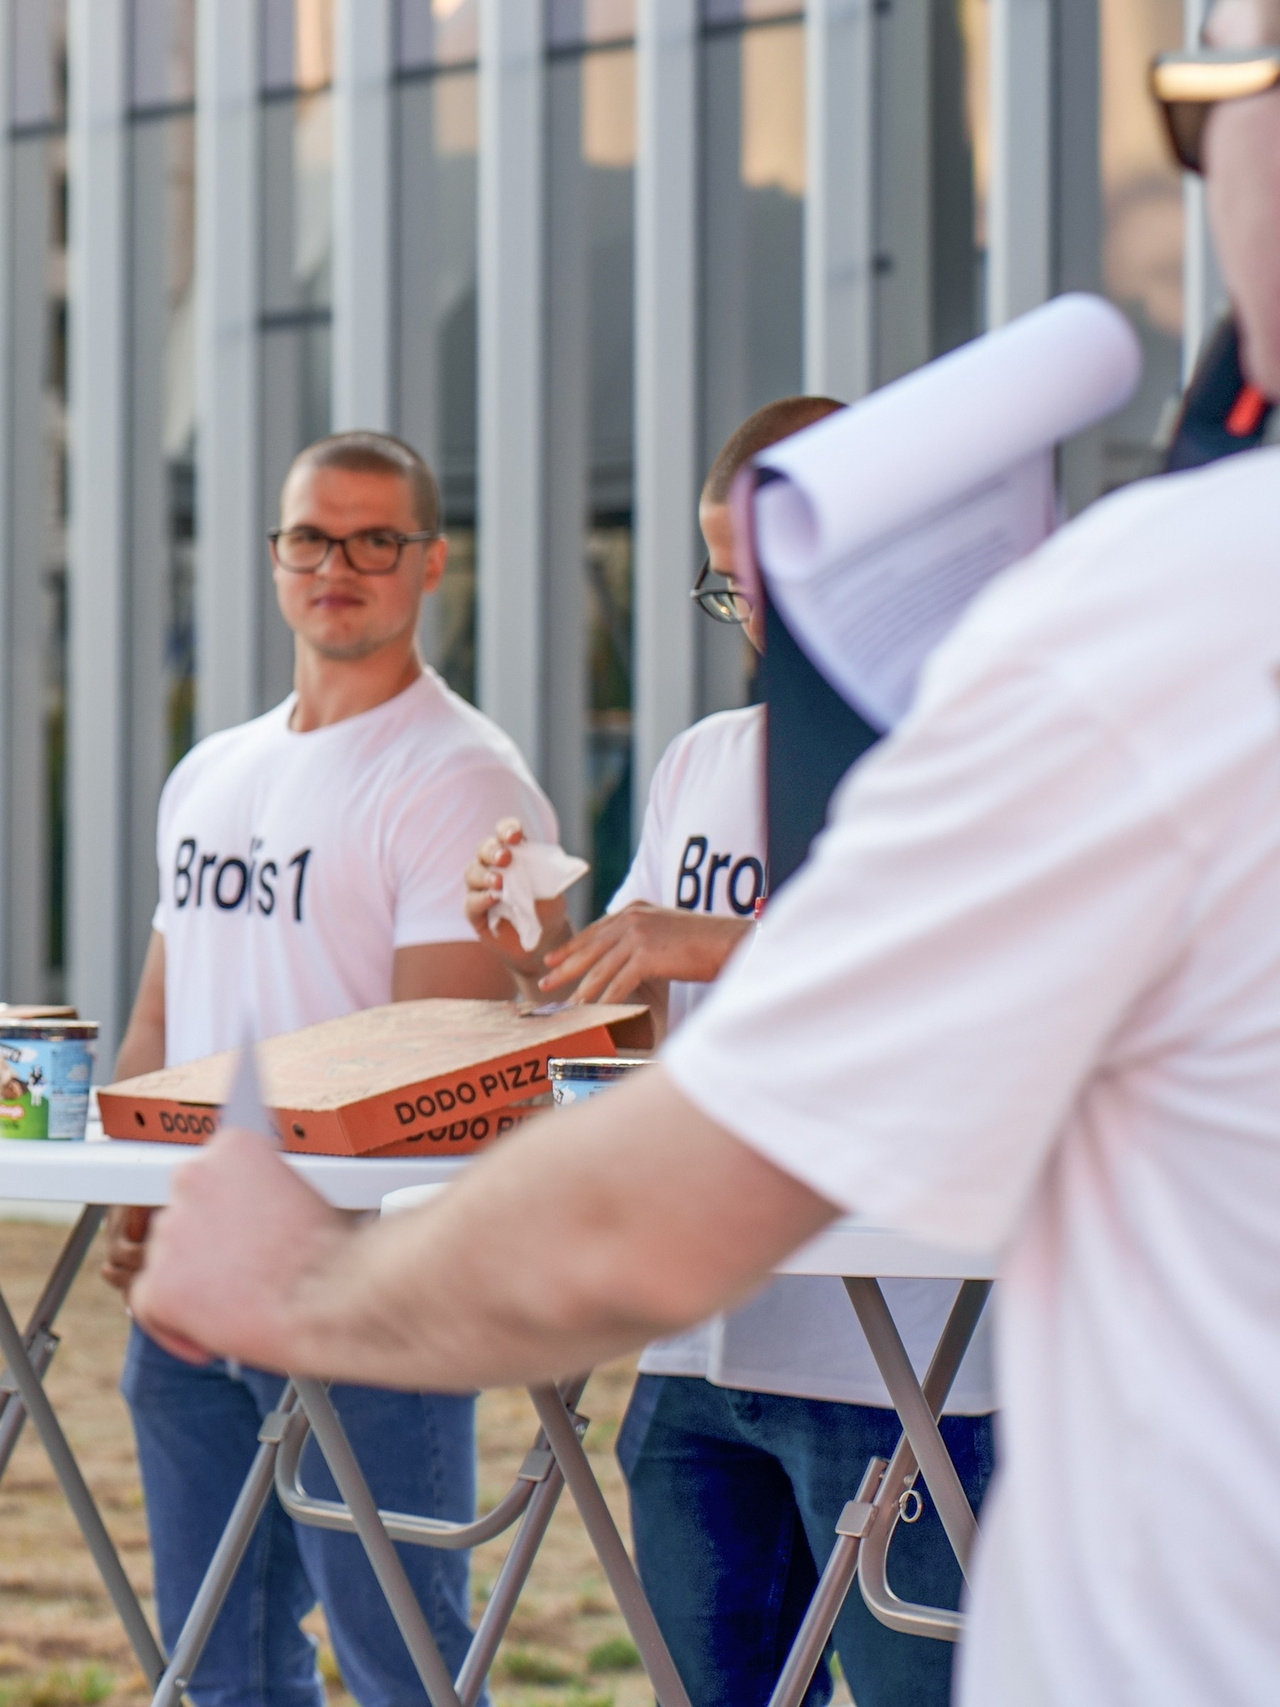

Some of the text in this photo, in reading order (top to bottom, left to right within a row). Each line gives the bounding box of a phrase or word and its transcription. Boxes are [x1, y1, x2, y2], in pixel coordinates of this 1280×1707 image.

[288, 847, 312, 922] 1
[160, 1111, 215, 1135] DODO
[394, 1057, 549, 1125] DODO PIZZ
